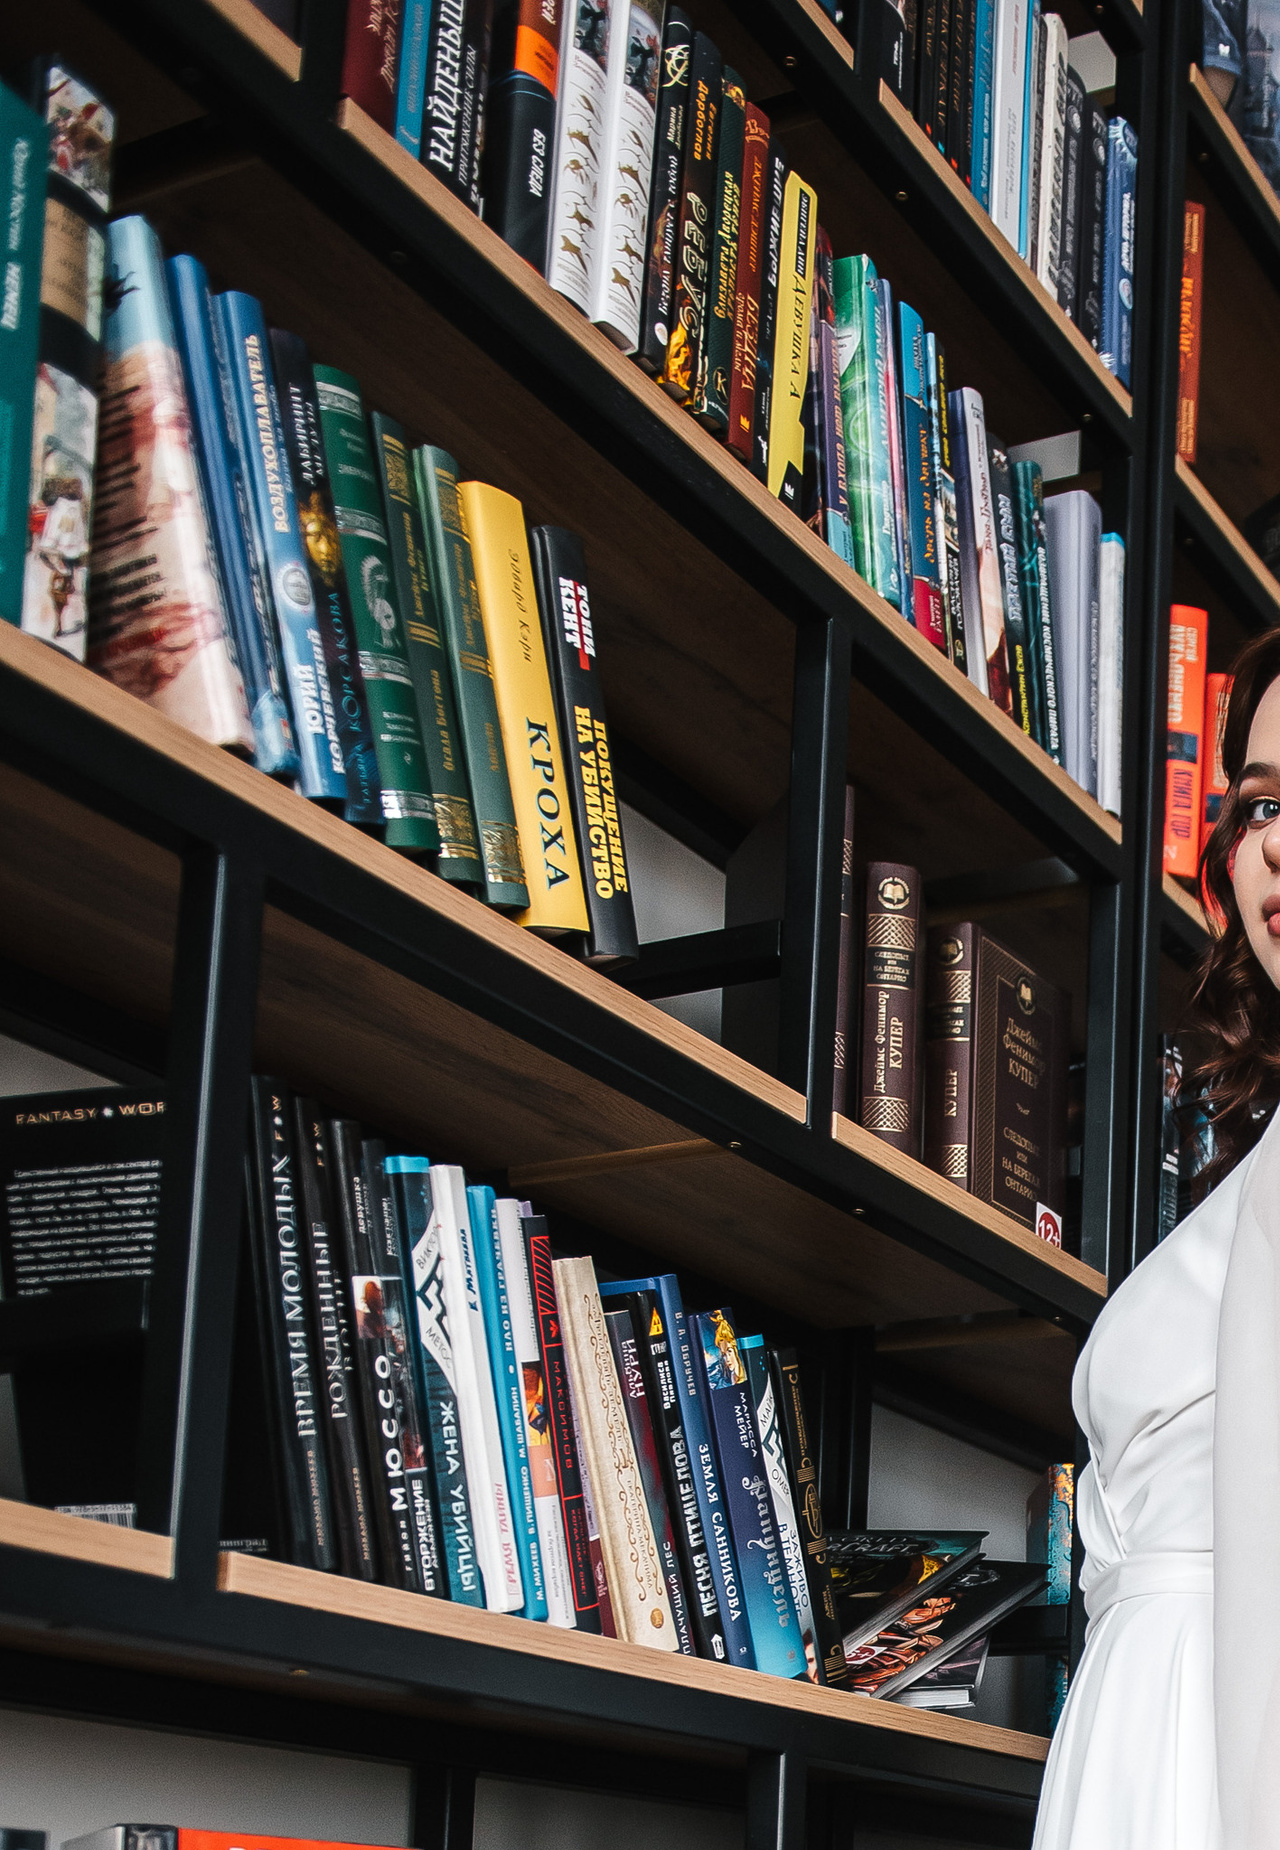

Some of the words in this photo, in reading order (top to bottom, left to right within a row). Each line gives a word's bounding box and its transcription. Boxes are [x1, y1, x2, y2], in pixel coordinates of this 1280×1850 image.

[528, 155, 545, 197] СЛЕДА
[533, 127, 547, 153] БЕЗ
[245, 334, 291, 532] ВОЗДУХОПЛАВАТЕЛЬ
[558, 576, 579, 649] КЕНТ
[576, 584, 597, 658] ТОНИ
[292, 663, 325, 735] ЮРИЙ
[573, 705, 591, 744] НА
[524, 717, 571, 889] КРОХА
[875, 990, 890, 1044] Фенимор
[889, 1016, 904, 1069] КУПЕР
[874, 1047, 887, 1094] Джеймс
[1008, 1057, 1040, 1090] КУПЕР
[16, 1108, 96, 1125] FANTASY
[271, 1153, 303, 1322] МОЛОДЫХ
[1038, 1218, 1061, 1249] 12+
[312, 1222, 348, 1419] РОЖДЕННЫЕ
[289, 1331, 317, 1437] ВРЕМЯ
[627, 1338, 646, 1398] НУРИ
[374, 1355, 409, 1512] МЮССО
[439, 1401, 461, 1475] ЖЕНА
[450, 1484, 476, 1592] УБИЙЦЫ
[670, 1425, 703, 1548] ПТИЦЕЛОВА
[411, 1479, 436, 1592] ВТОРЖЕНИЕ
[661, 1540, 675, 1568] ЛЕС
[699, 1443, 719, 1504] ЗЕМЛЯ
[710, 1511, 742, 1622] САННИКОВА
[692, 1555, 719, 1618] ПЕСНЯ
